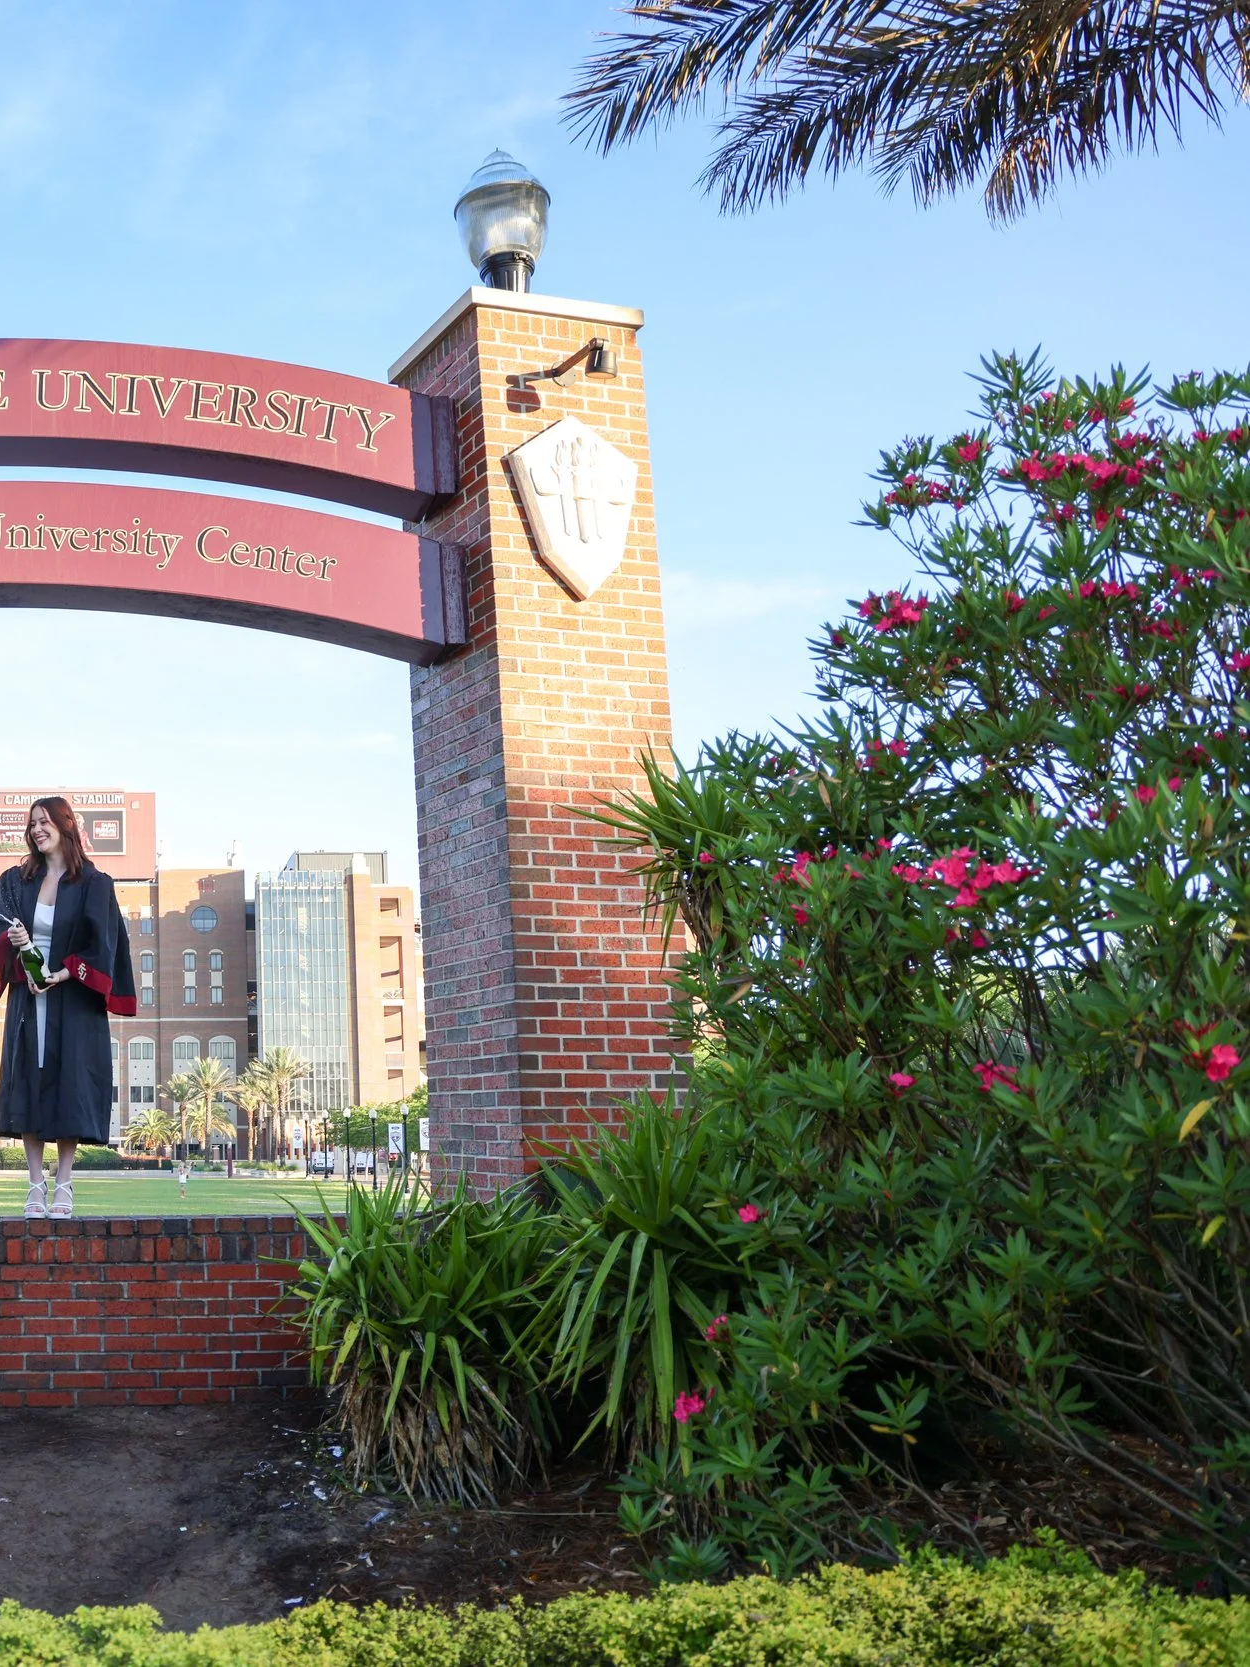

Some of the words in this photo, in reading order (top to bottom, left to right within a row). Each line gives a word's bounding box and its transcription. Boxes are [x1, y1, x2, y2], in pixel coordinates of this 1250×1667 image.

[32, 370, 395, 452] UNIVERSITY
[195, 526, 338, 581] Center
[4, 794, 64, 805] CAMP
[72, 794, 125, 804] STADIUM
